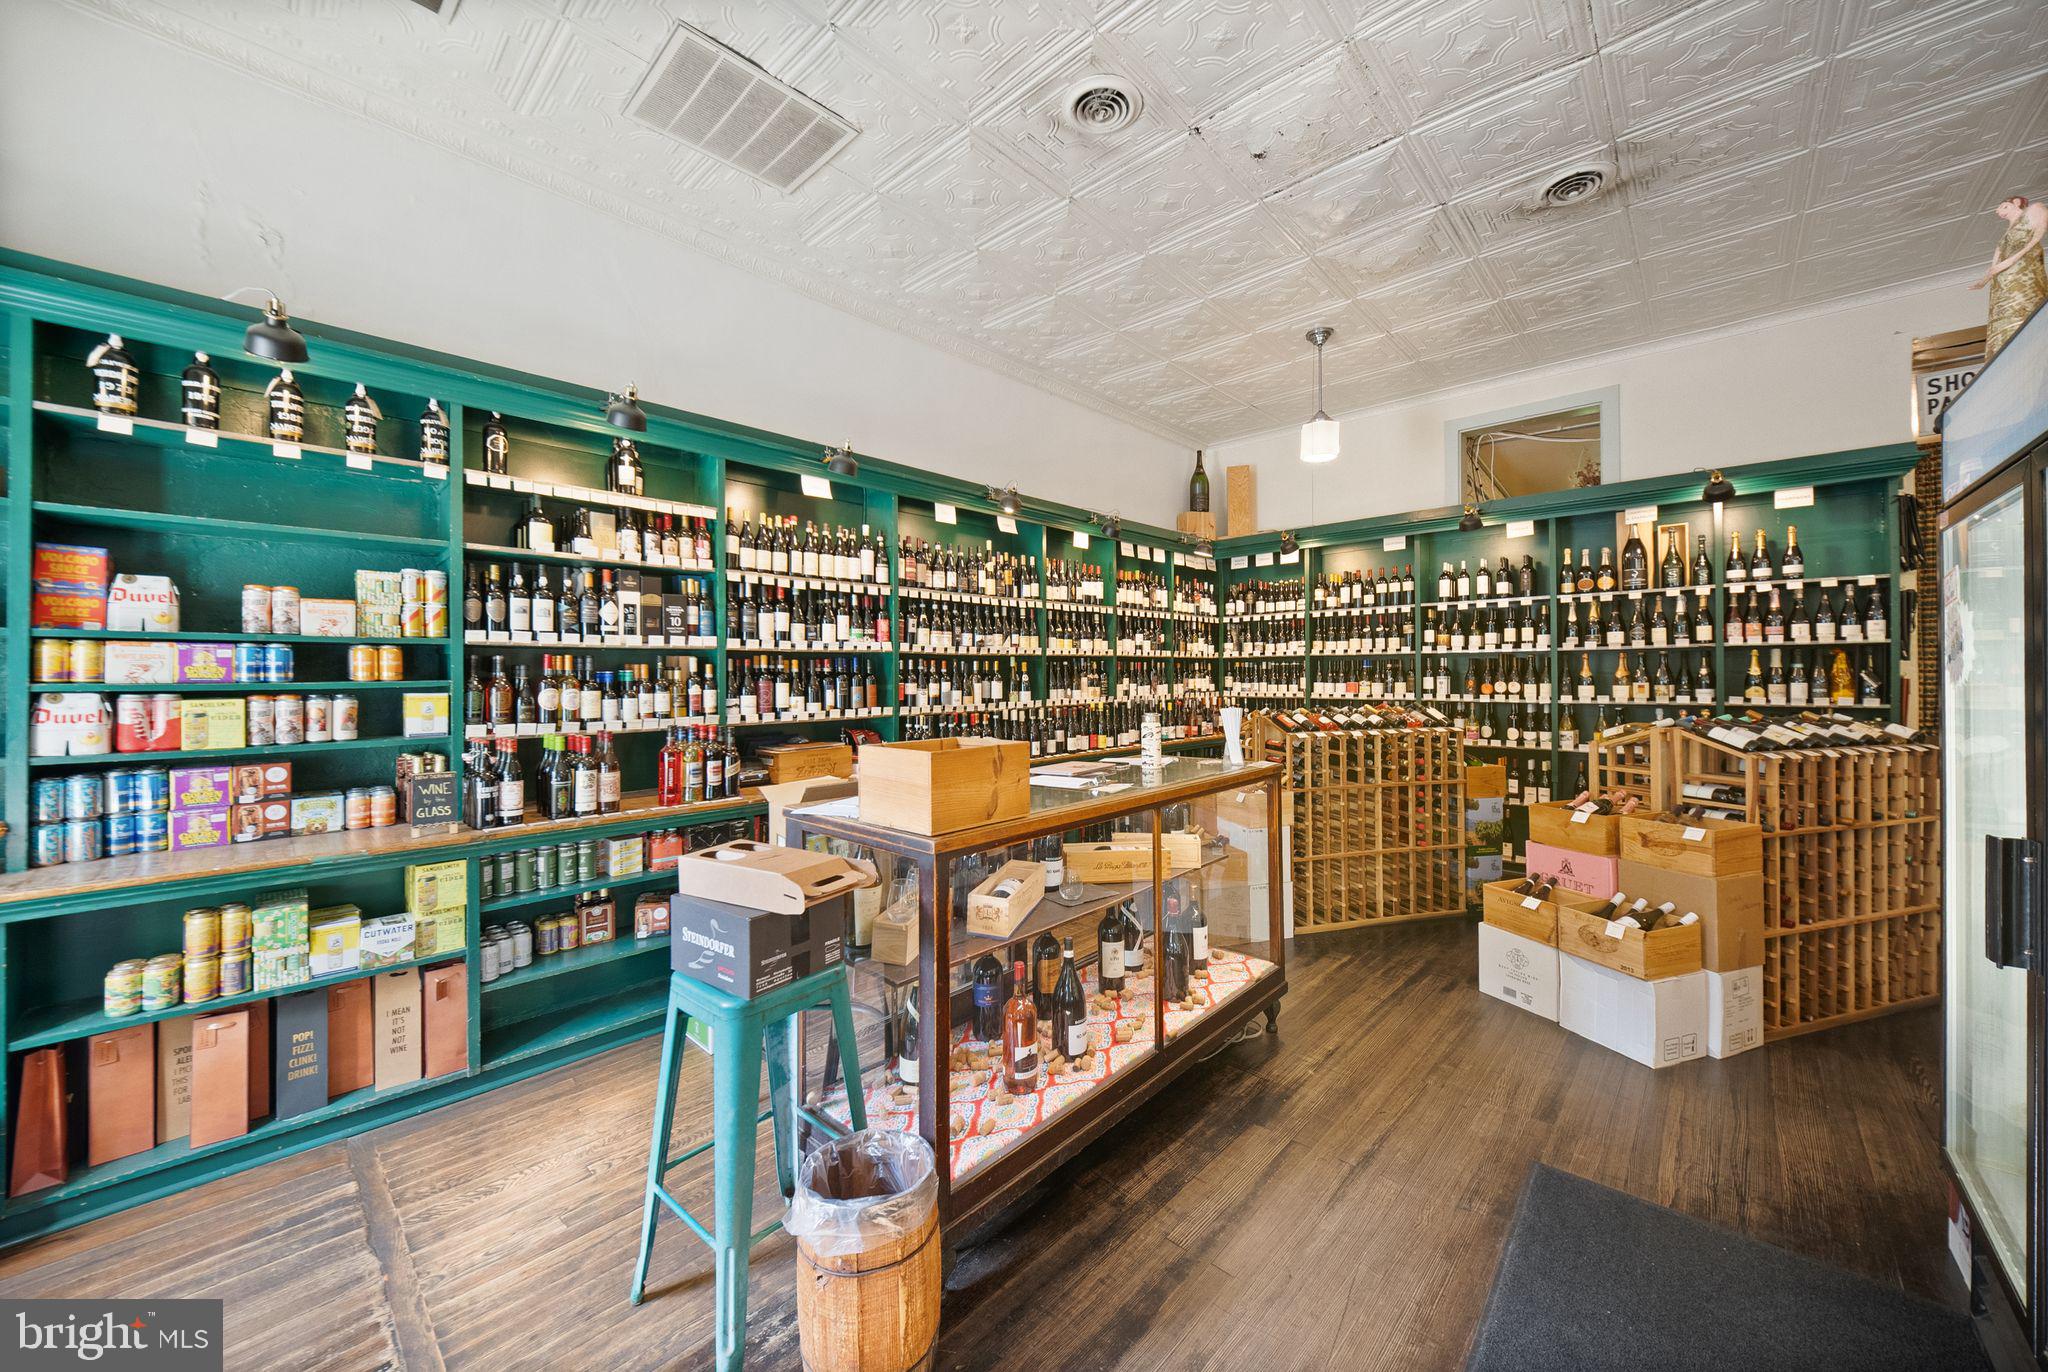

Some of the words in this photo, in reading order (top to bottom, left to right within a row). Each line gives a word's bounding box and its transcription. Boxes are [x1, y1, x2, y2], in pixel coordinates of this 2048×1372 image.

[111, 587, 174, 604] Duvel
[670, 617, 682, 626] 10
[33, 708, 104, 724] Duvel
[418, 782, 452, 794] WINE
[416, 806, 452, 818] GLASS
[364, 924, 413, 939] CUTWATER
[682, 926, 735, 958] STEINDORFER
[391, 1006, 411, 1016] MEAN
[391, 1025, 405, 1035] NOT
[292, 1030, 314, 1043] POP!
[391, 1035, 406, 1044] NOT
[292, 1043, 314, 1055] FIZZ!
[390, 1044, 408, 1054] WINE
[289, 1055, 317, 1068] CLINK!
[288, 1065, 319, 1081] DRINK!
[172, 1077, 189, 1087] THIS
[173, 1086, 188, 1096] FOR
[178, 1095, 192, 1104] LAB
